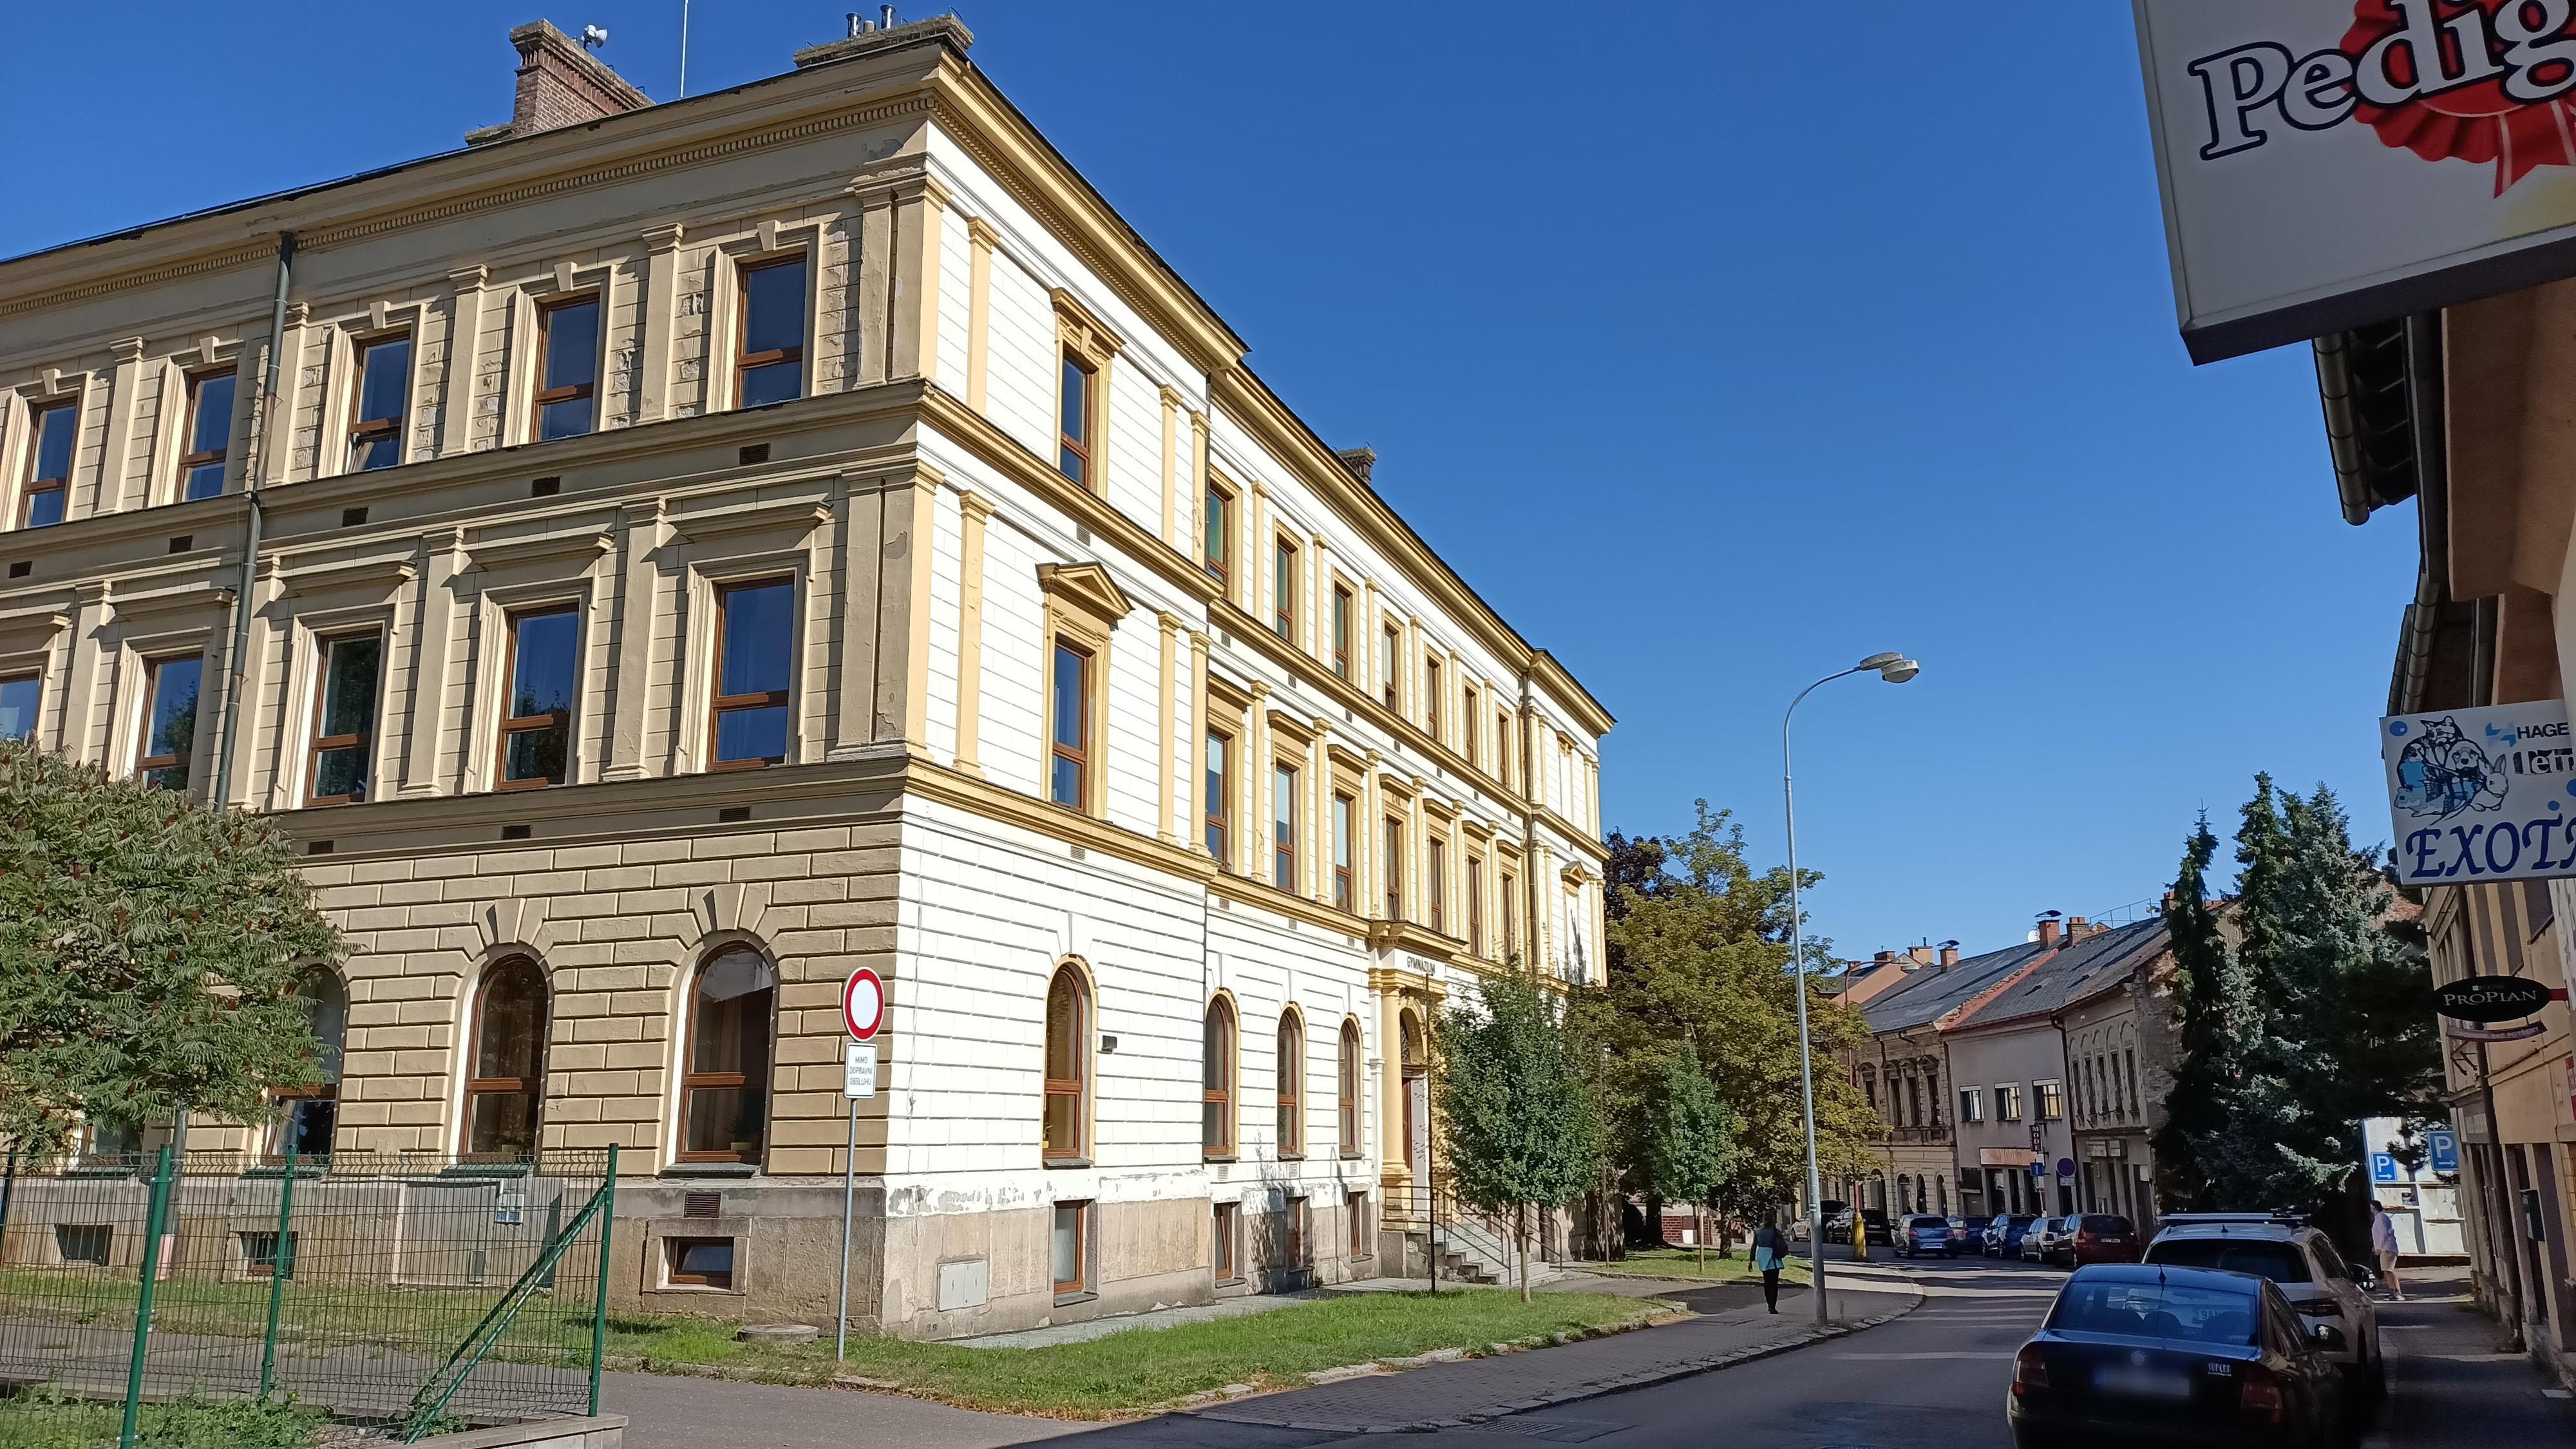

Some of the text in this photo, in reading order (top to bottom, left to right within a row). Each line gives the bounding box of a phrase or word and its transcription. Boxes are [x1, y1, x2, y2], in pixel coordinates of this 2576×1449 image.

[2517, 722, 2570, 739] HAGE
[1407, 956, 1435, 974] GYMNÁZIUM
[849, 1066, 873, 1075] DOPRAVNÍ
[2032, 1126, 2040, 1151] MODE
[2434, 1135, 2452, 1158] P
[2376, 1155, 2390, 1172] P
